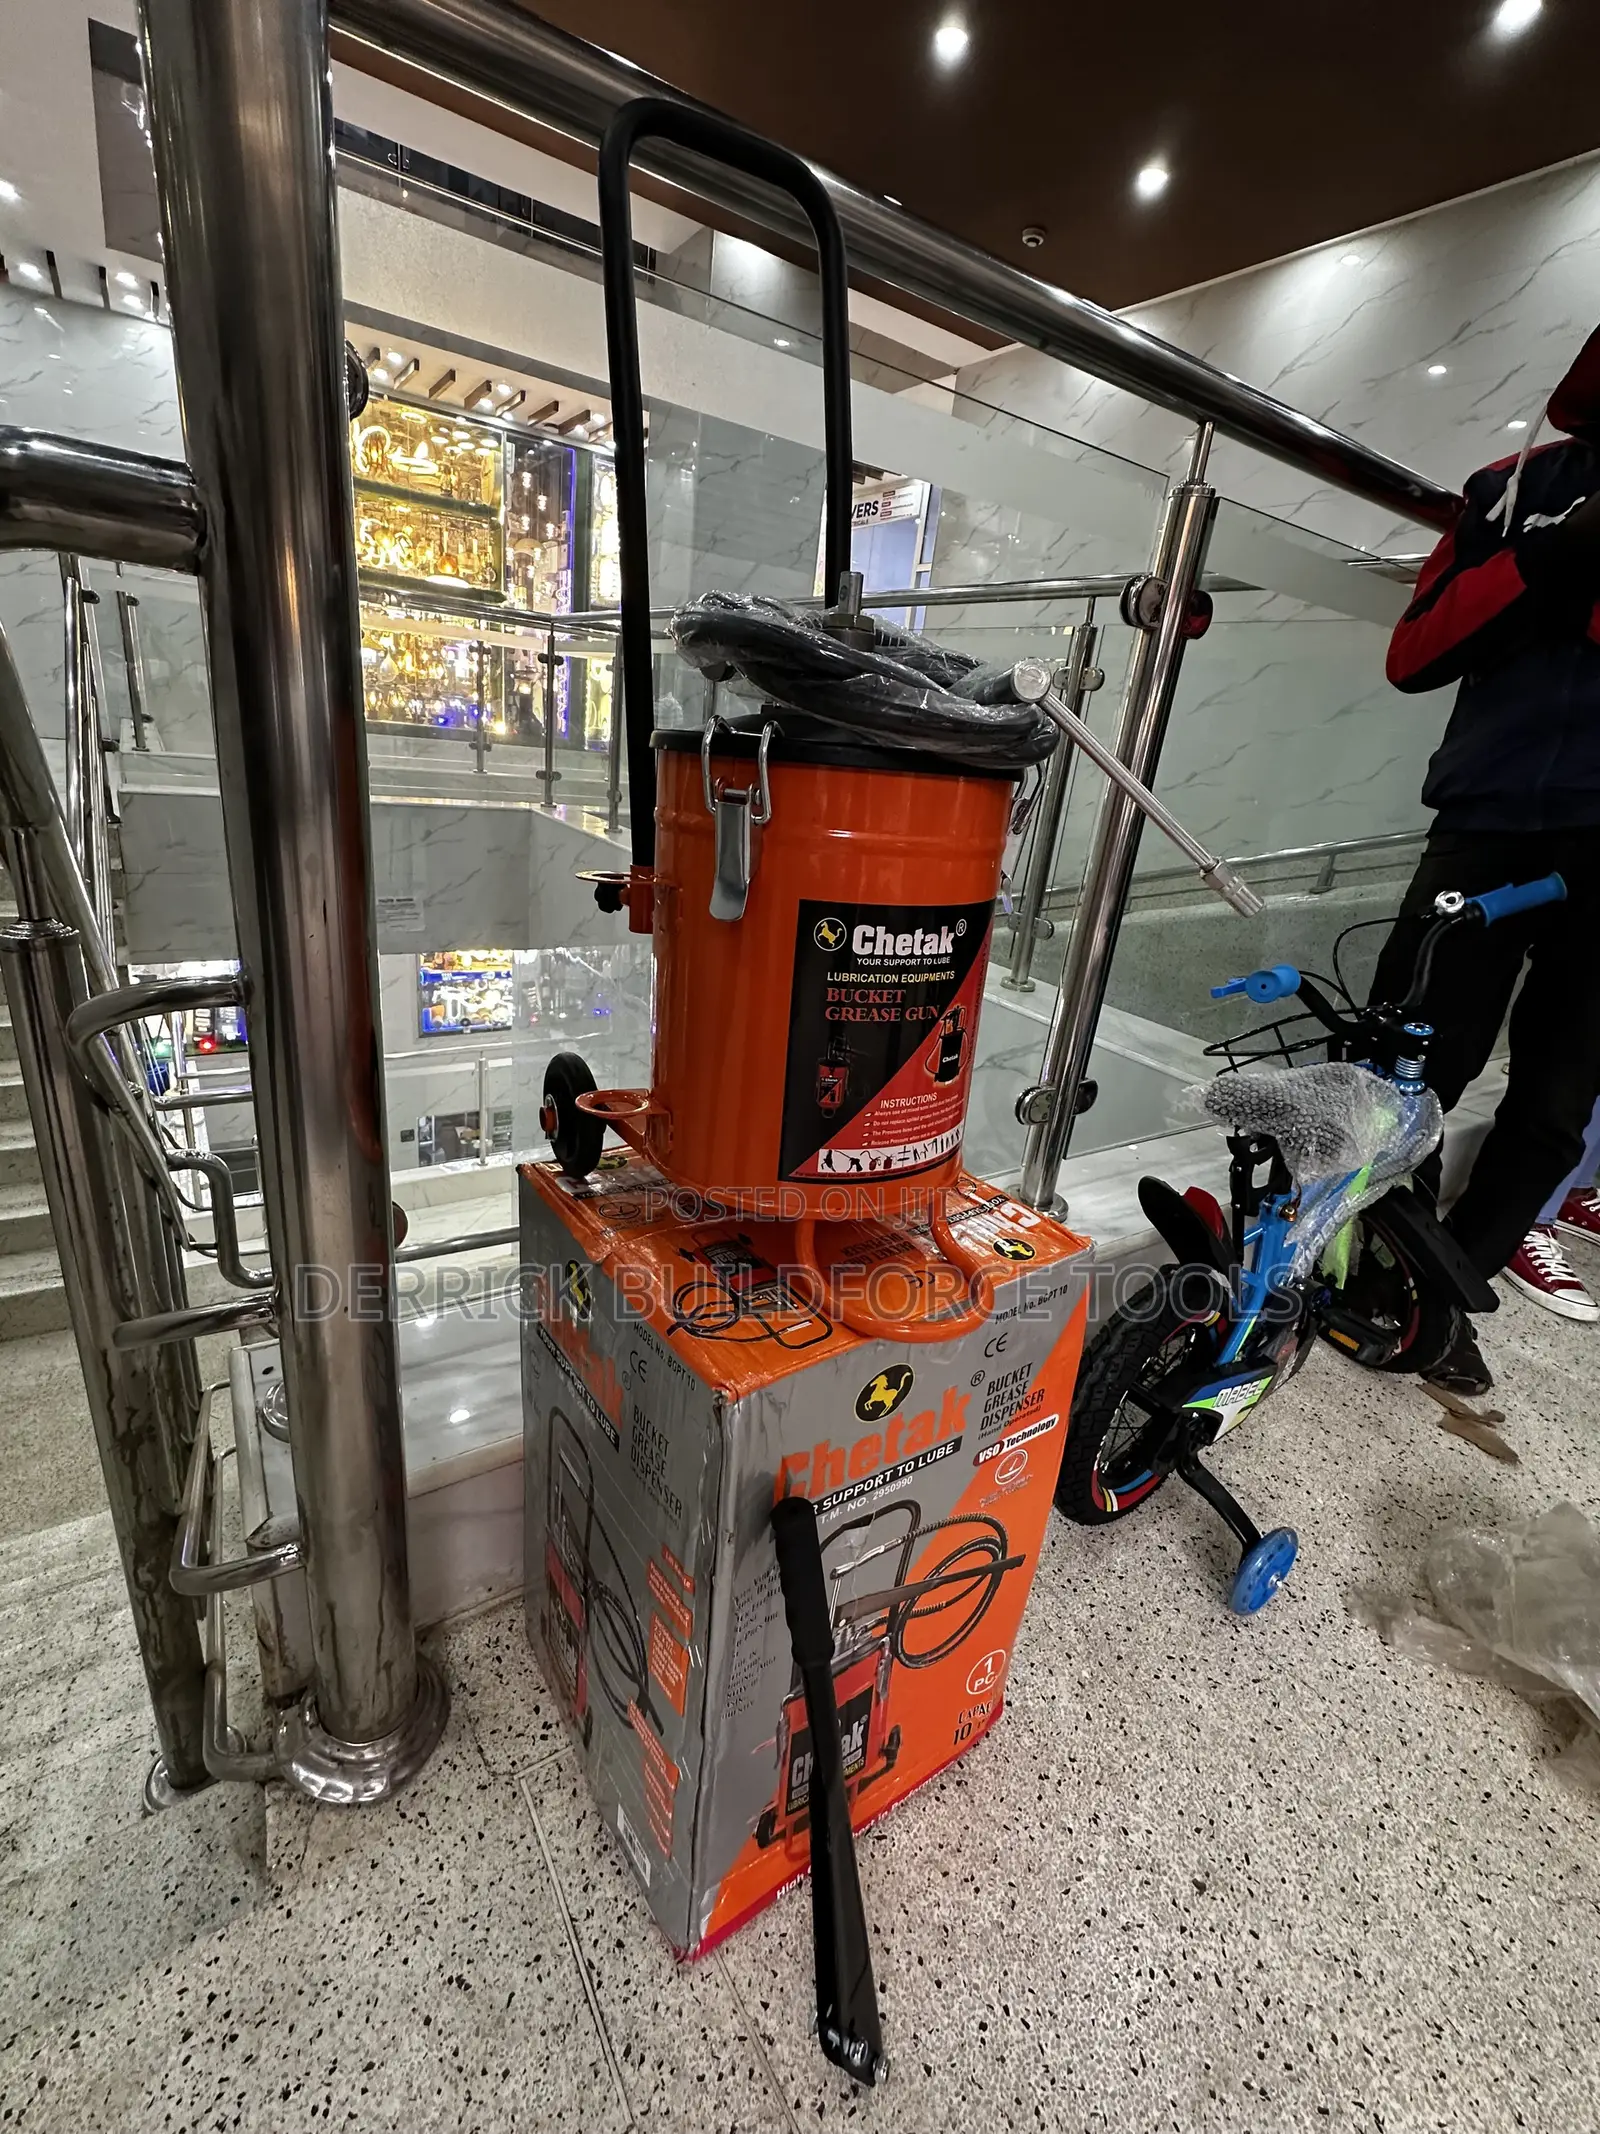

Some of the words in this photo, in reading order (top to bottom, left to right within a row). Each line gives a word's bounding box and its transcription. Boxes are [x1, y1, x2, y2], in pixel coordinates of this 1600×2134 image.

[852, 924, 955, 956] Chetak
[827, 971, 899, 983] LUBRICATION
[901, 970, 955, 983] EQUIPMENTS
[857, 958, 881, 966] YOUR
[883, 958, 920, 966] SUPPORT
[922, 958, 932, 966] TO
[933, 956, 951, 965] LUBE
[825, 1006, 902, 1022] GREASE
[905, 1005, 940, 1021] GUN
[826, 987, 907, 1004] BUCKET
[880, 1092, 938, 1109] INSTRUCTIONS
[995, 1304, 1021, 1325] MODEL
[1059, 1284, 1068, 1296] 10
[633, 1321, 654, 1350] MODEL
[687, 1375, 696, 1391] 10
[983, 1380, 1030, 1413] GREASE
[987, 1361, 1034, 1397] BUCKET
[596, 1409, 617, 1444] LUBE
[980, 1388, 1045, 1431] DISPENSER
[633, 1404, 670, 1457] BUCKET
[979, 1443, 1001, 1464] VSO
[1006, 1416, 1057, 1448] Technology
[632, 1425, 667, 1479] GREASE
[630, 1444, 682, 1519] DISPENSER
[822, 1470, 893, 1511] SUPPORT
[897, 1460, 915, 1476] TO
[917, 1441, 955, 1468] LUBE
[847, 1496, 870, 1512] NO.
[873, 1475, 914, 1501] 2950990
[953, 1722, 973, 1746] 10
